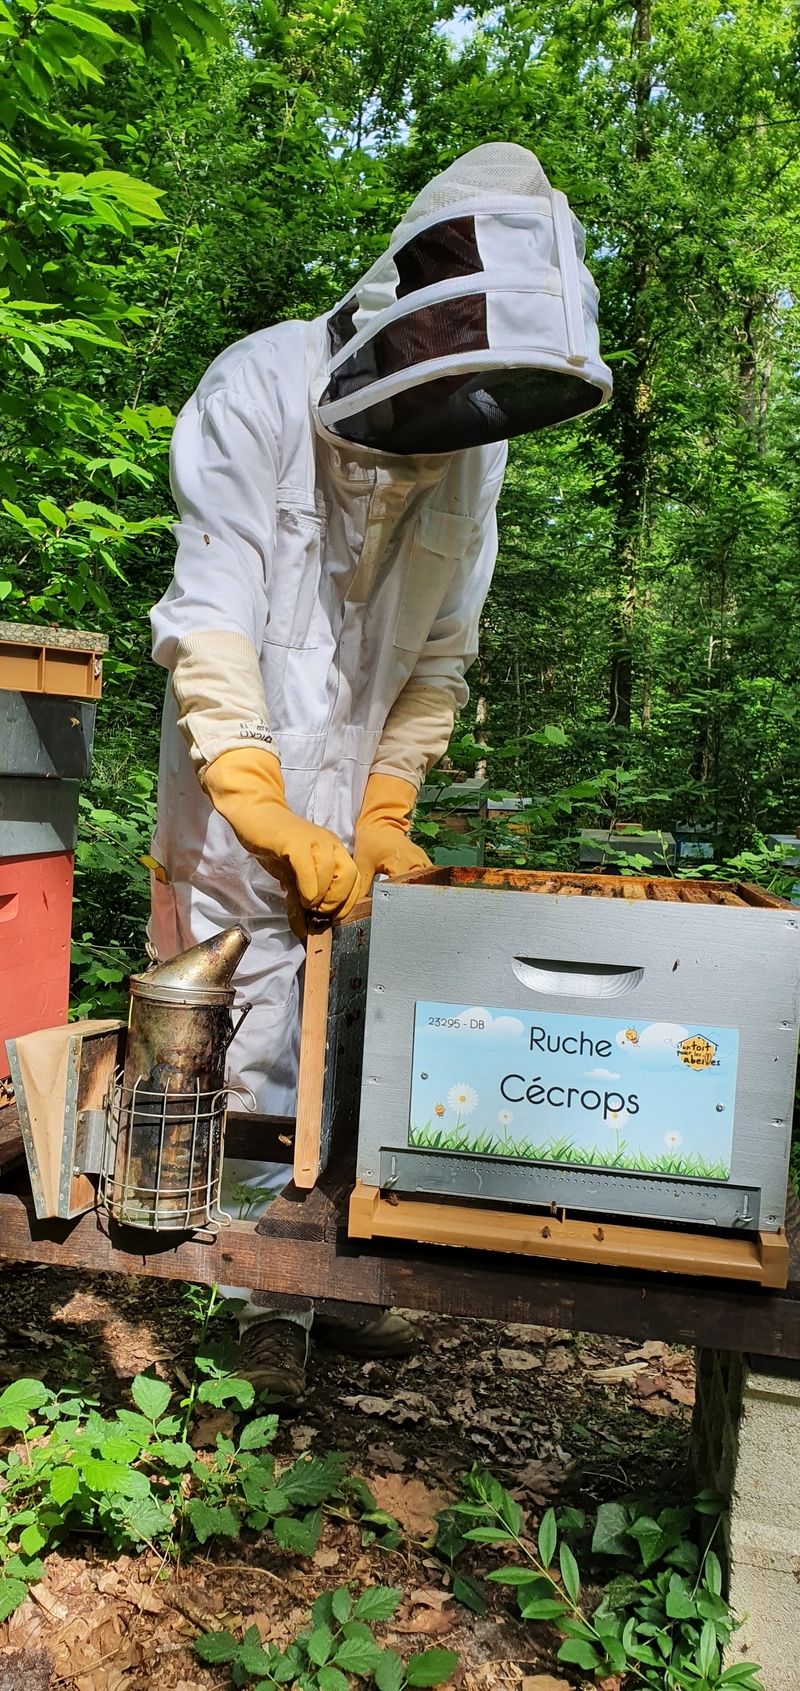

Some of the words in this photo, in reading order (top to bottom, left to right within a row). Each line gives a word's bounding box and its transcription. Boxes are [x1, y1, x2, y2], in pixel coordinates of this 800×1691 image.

[428, 1016, 461, 1029] 23295
[470, 1019, 485, 1030] DB
[529, 1026, 612, 1058] Ruche
[691, 1041, 711, 1052] toit
[500, 1073, 640, 1120] Cécrops
